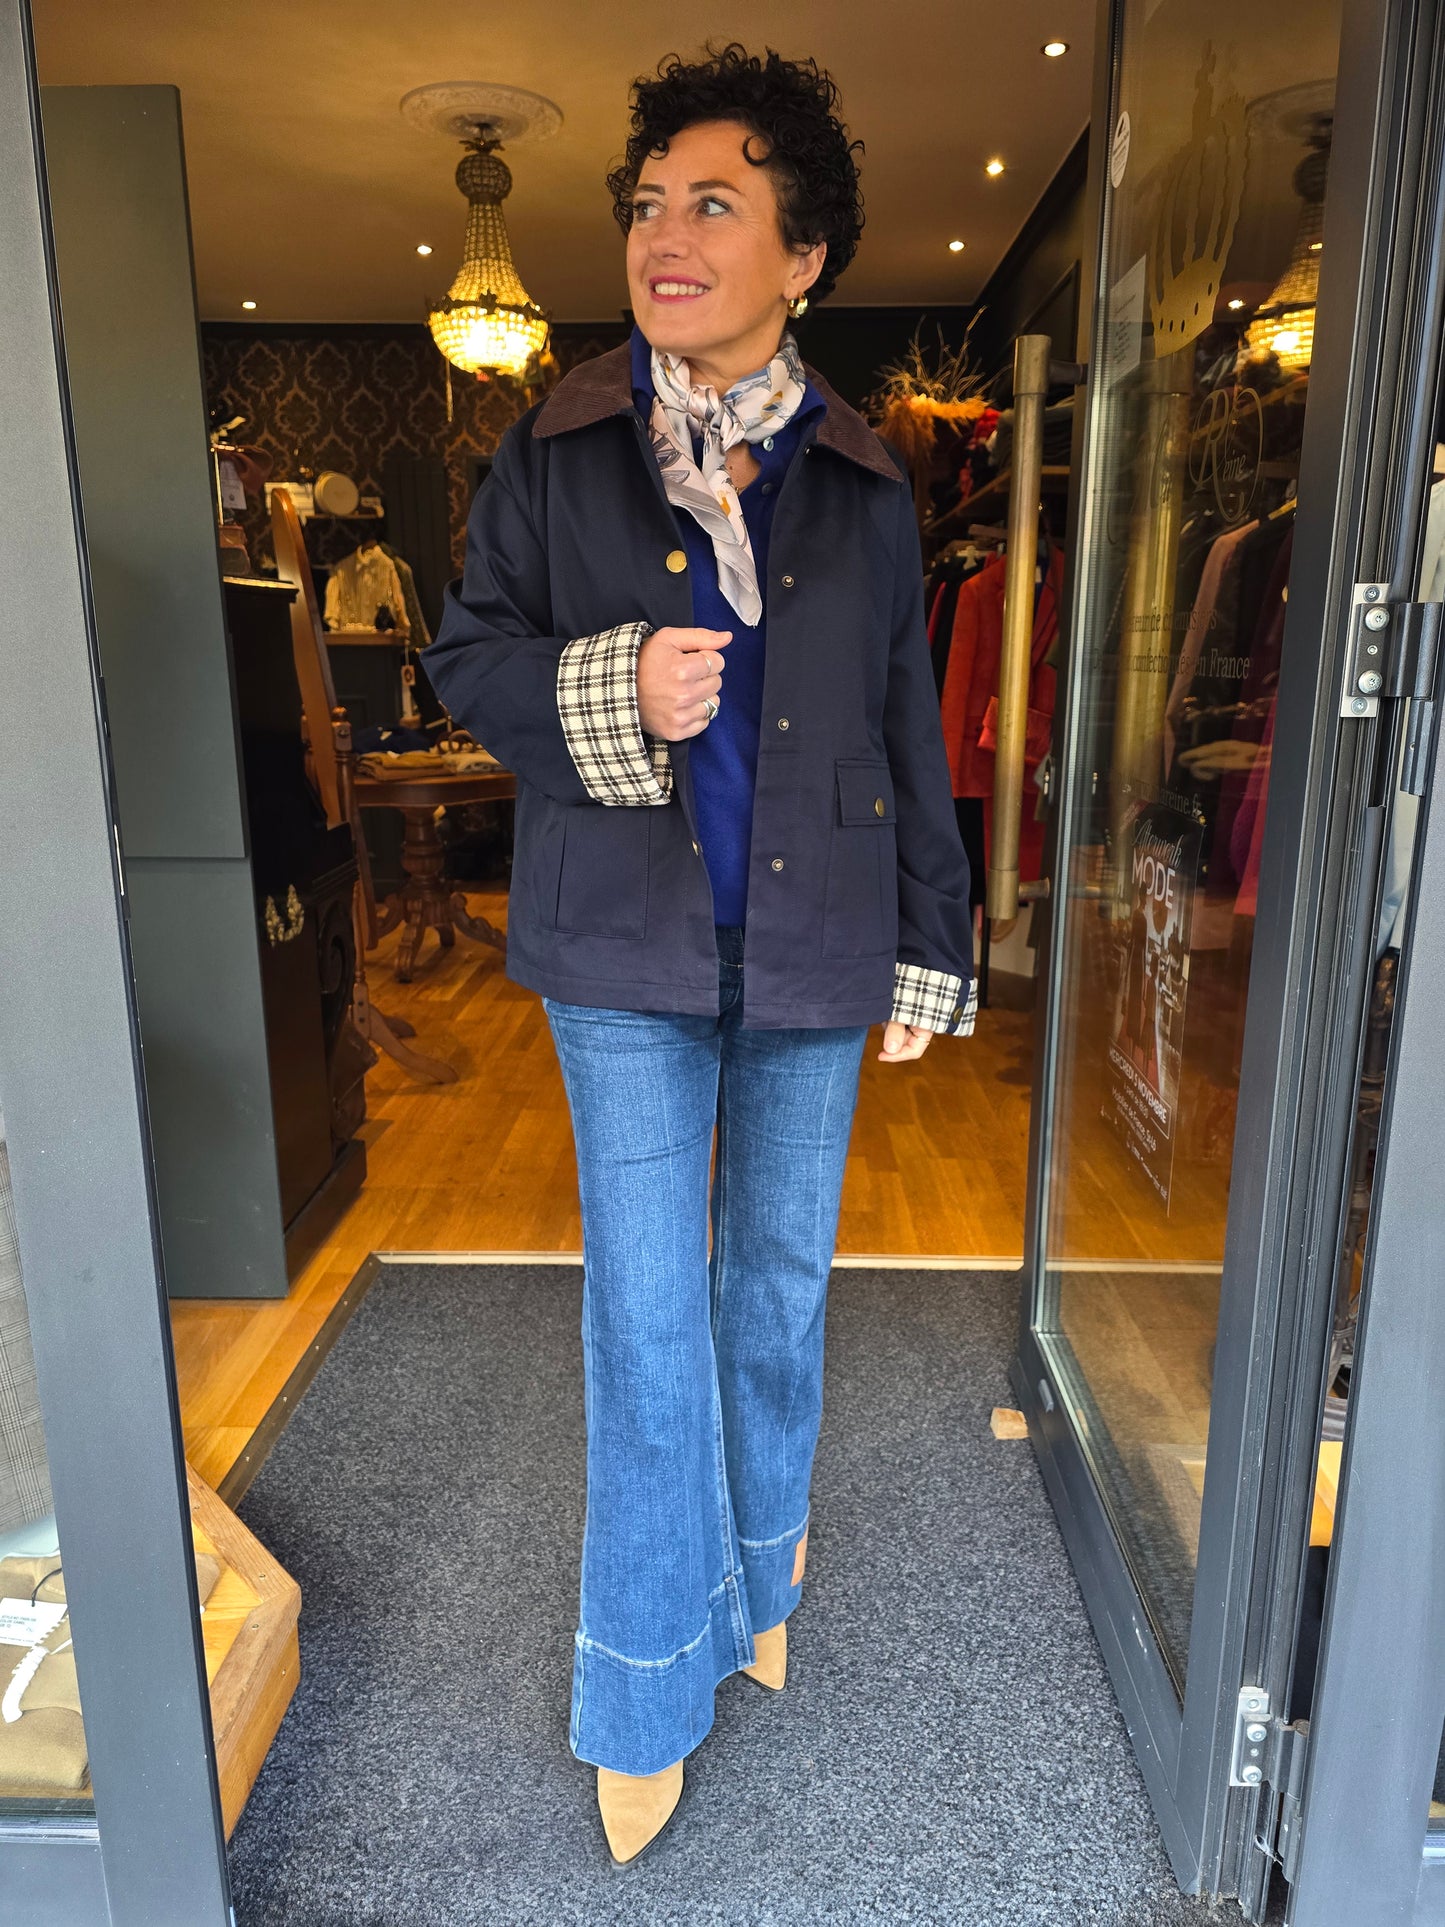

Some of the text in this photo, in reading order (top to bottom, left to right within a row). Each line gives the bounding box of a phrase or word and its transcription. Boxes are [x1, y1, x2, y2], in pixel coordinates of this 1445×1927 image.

[1209, 647, 1251, 680] France
[1131, 847, 1176, 910] MODE
[1109, 1046, 1134, 1083] MERCREDI
[1137, 1076, 1168, 1125] NOVEMBRE
